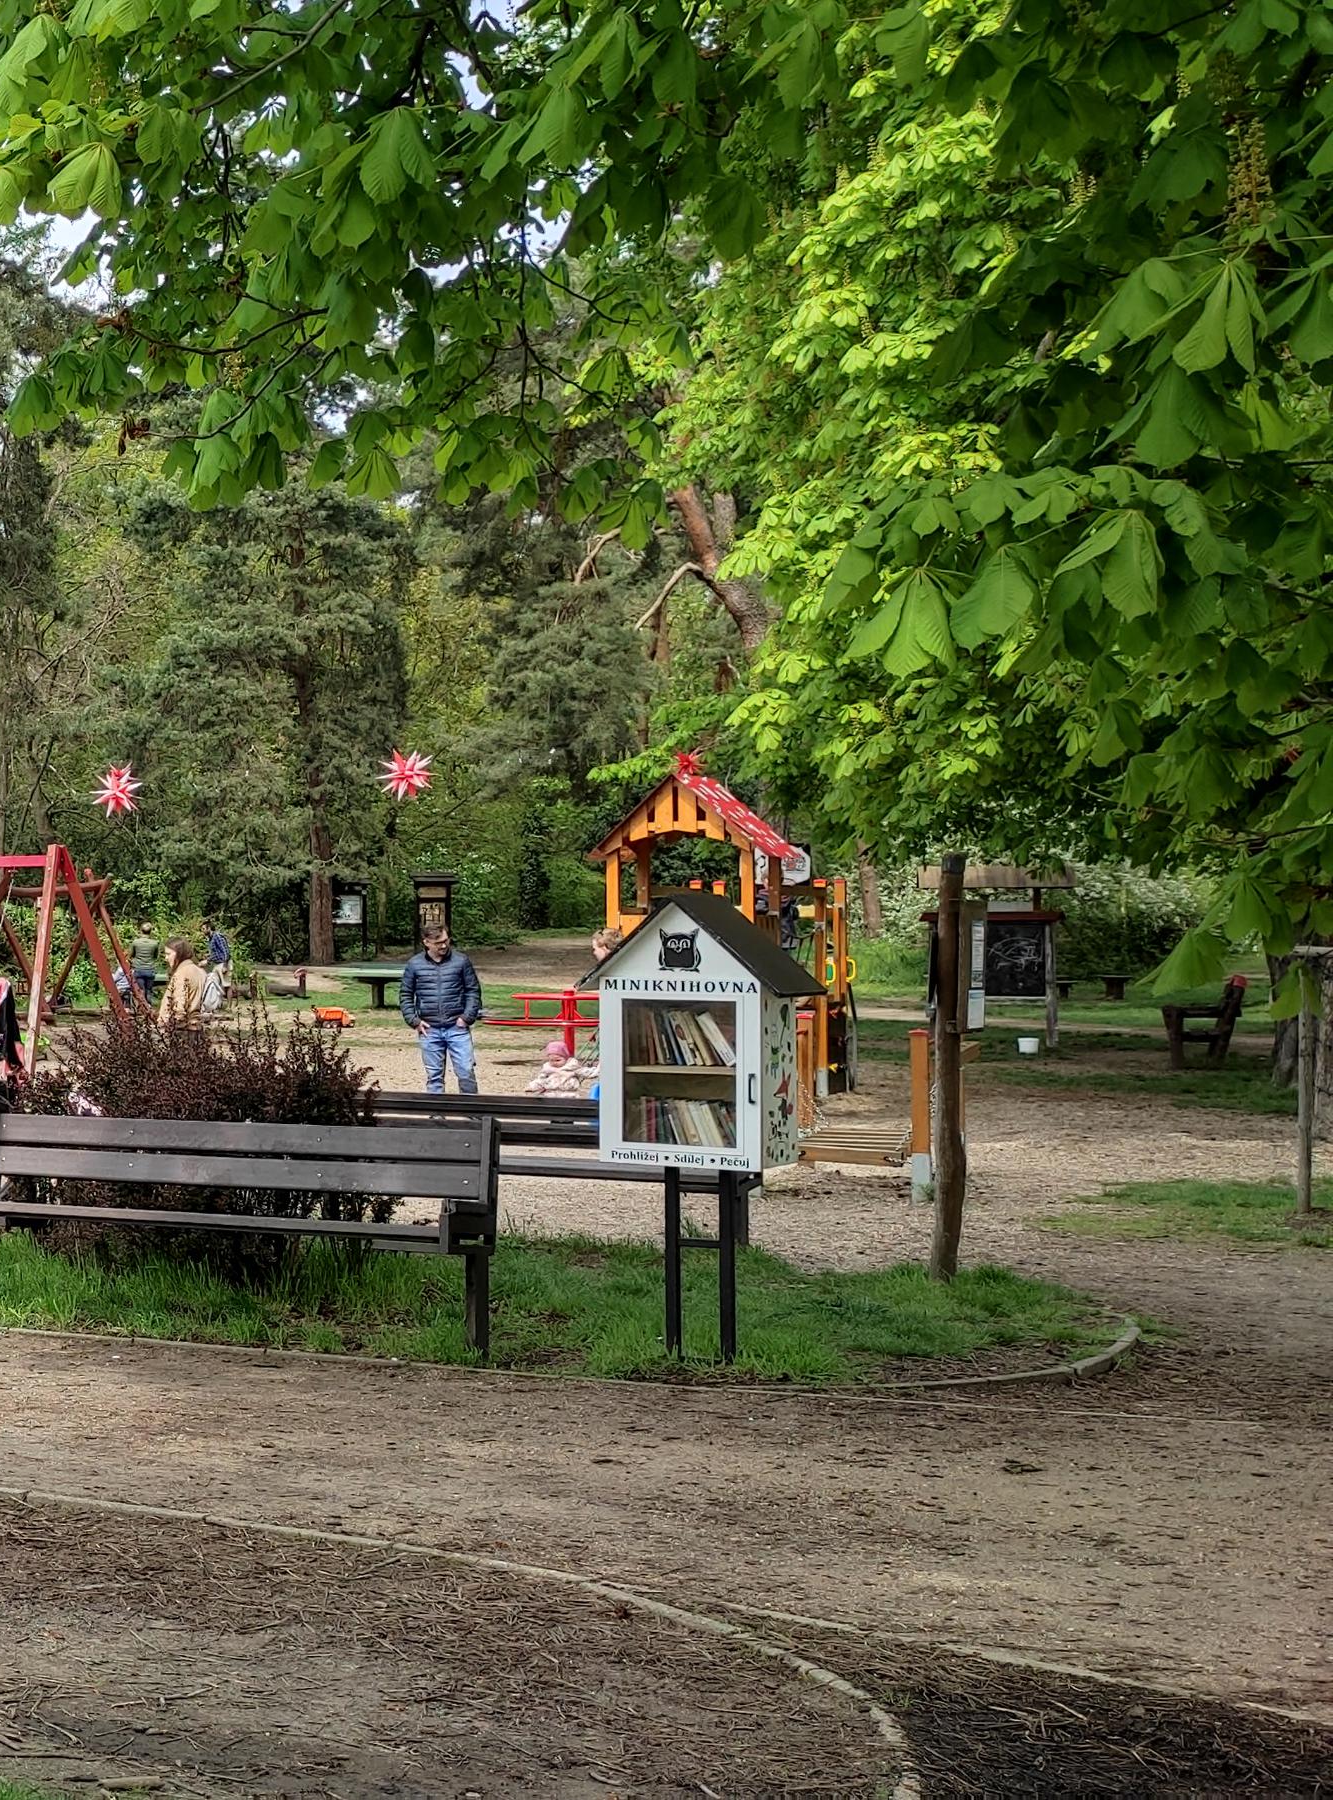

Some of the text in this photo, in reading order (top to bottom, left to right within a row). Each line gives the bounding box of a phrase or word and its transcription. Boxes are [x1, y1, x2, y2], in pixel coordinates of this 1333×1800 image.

[604, 979, 758, 993] MINIKNIHOVNA
[611, 1150, 750, 1169] Prohlížej Sdílej Pečuj
